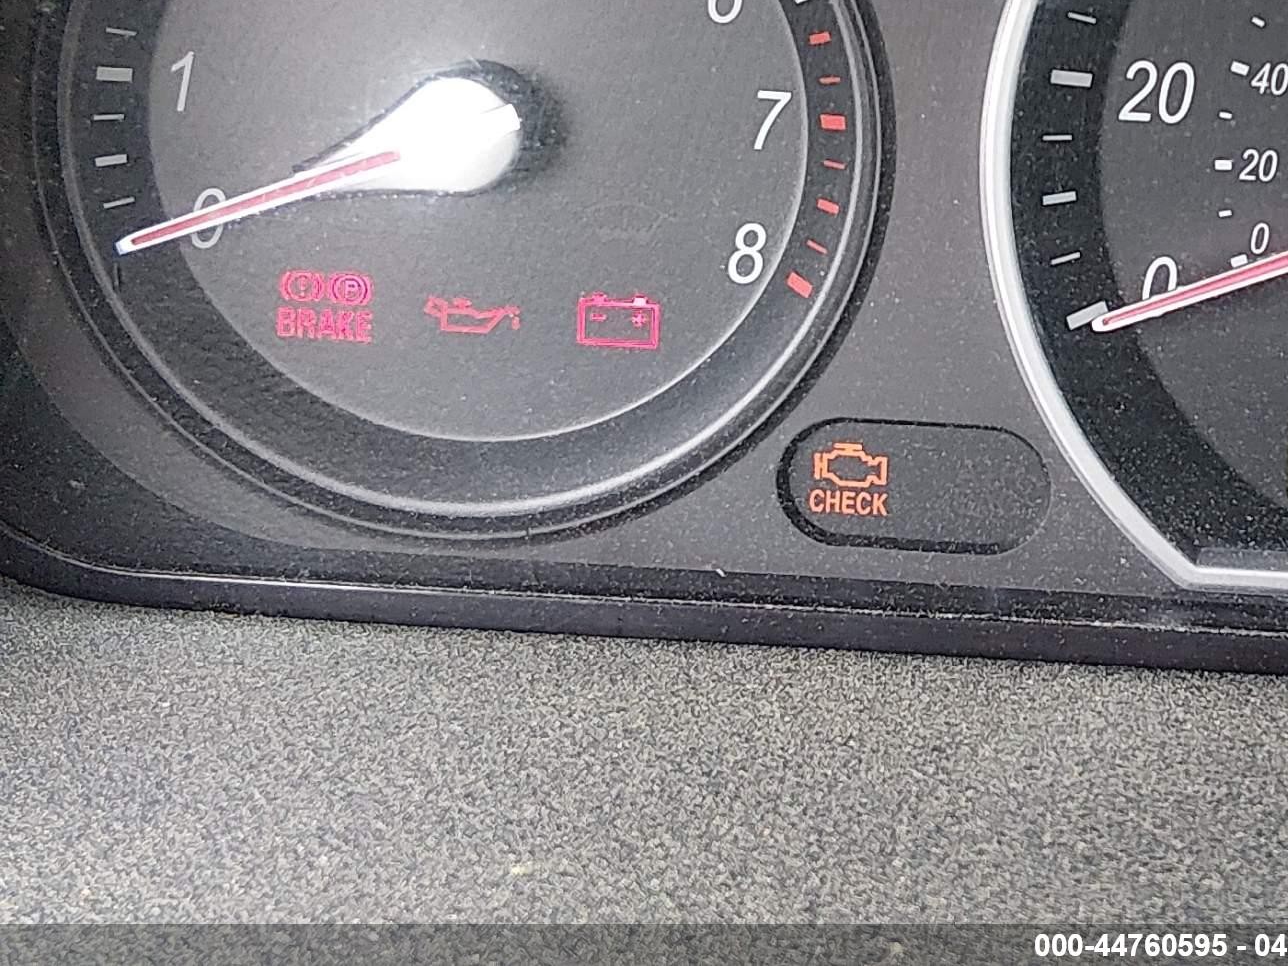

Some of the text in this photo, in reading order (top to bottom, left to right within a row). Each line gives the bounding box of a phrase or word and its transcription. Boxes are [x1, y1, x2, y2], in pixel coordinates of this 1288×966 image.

[170, 51, 195, 112] 1
[1118, 59, 1196, 125] 20
[754, 90, 792, 150] 7
[1239, 148, 1279, 182] 20
[728, 223, 768, 285] 8
[1250, 222, 1270, 255] 0
[276, 306, 374, 344] BRAKE
[808, 489, 888, 517] CHECK
